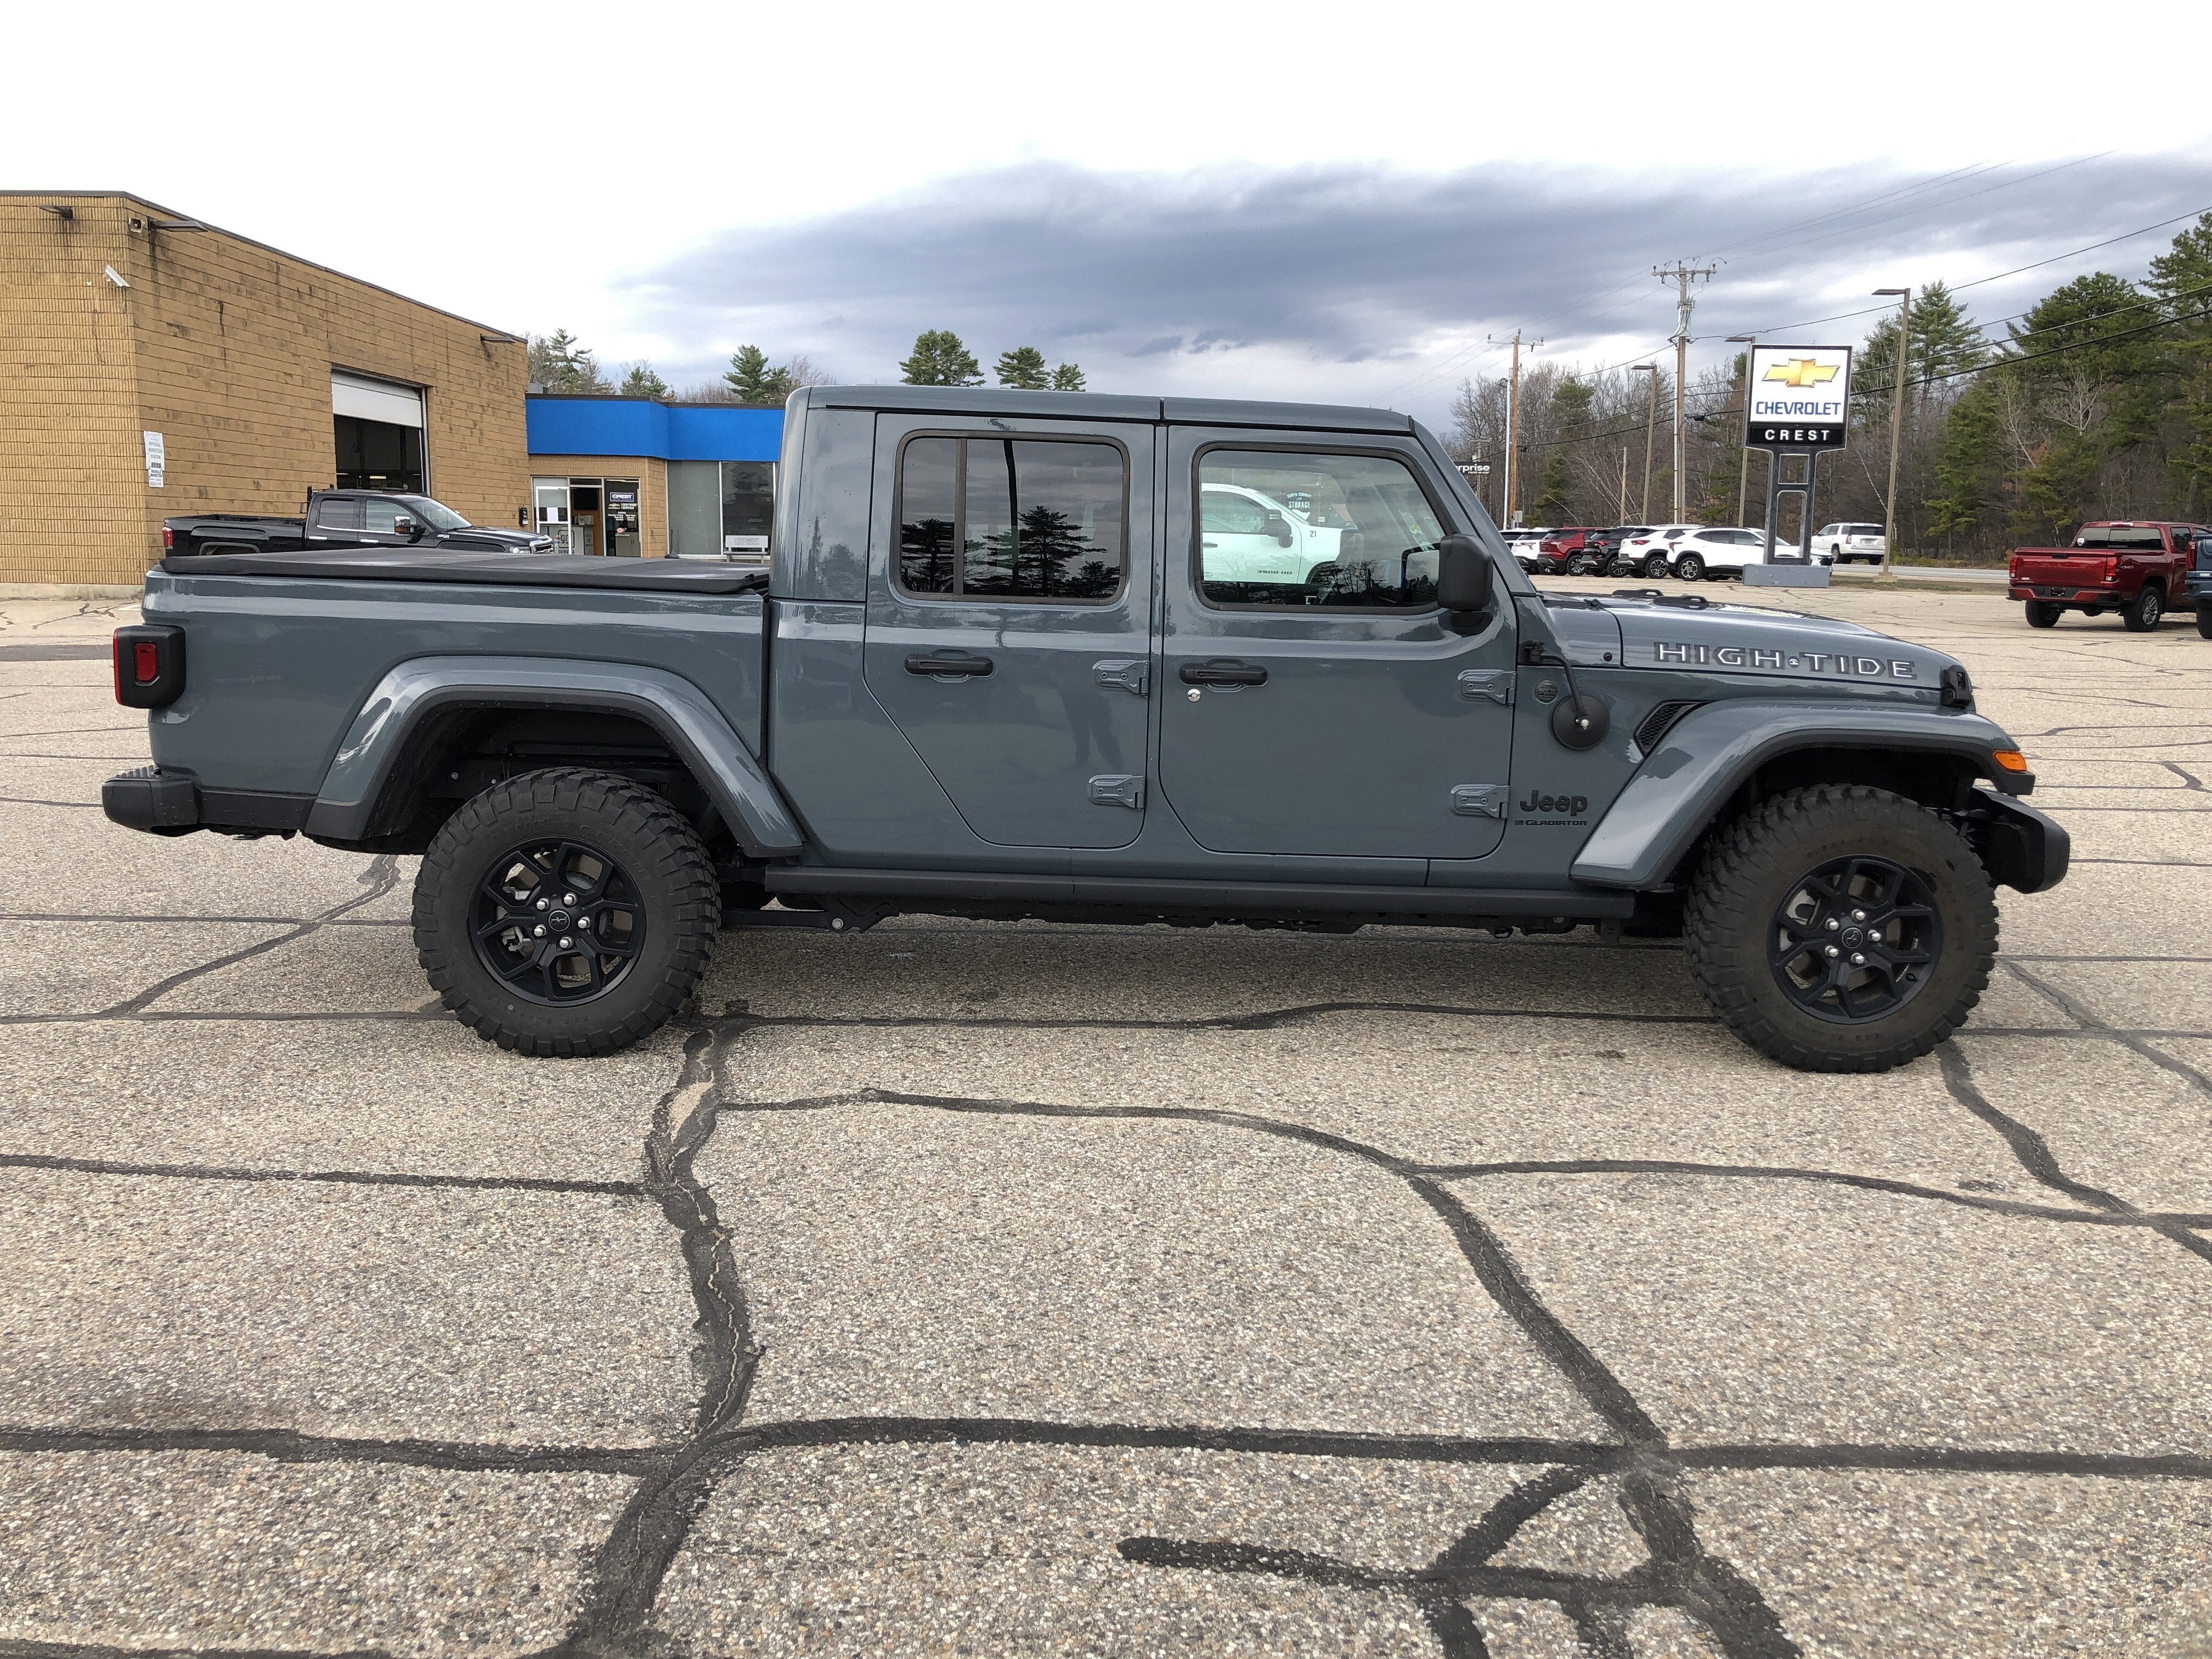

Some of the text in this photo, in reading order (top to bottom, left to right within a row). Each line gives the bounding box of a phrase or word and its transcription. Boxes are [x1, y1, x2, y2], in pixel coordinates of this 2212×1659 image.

[1756, 401, 1841, 415] CHEVROLET
[1764, 429, 1830, 441] CREST
[1654, 641, 1917, 680] HIGH TIDE
[1520, 789, 1587, 816] Jeep
